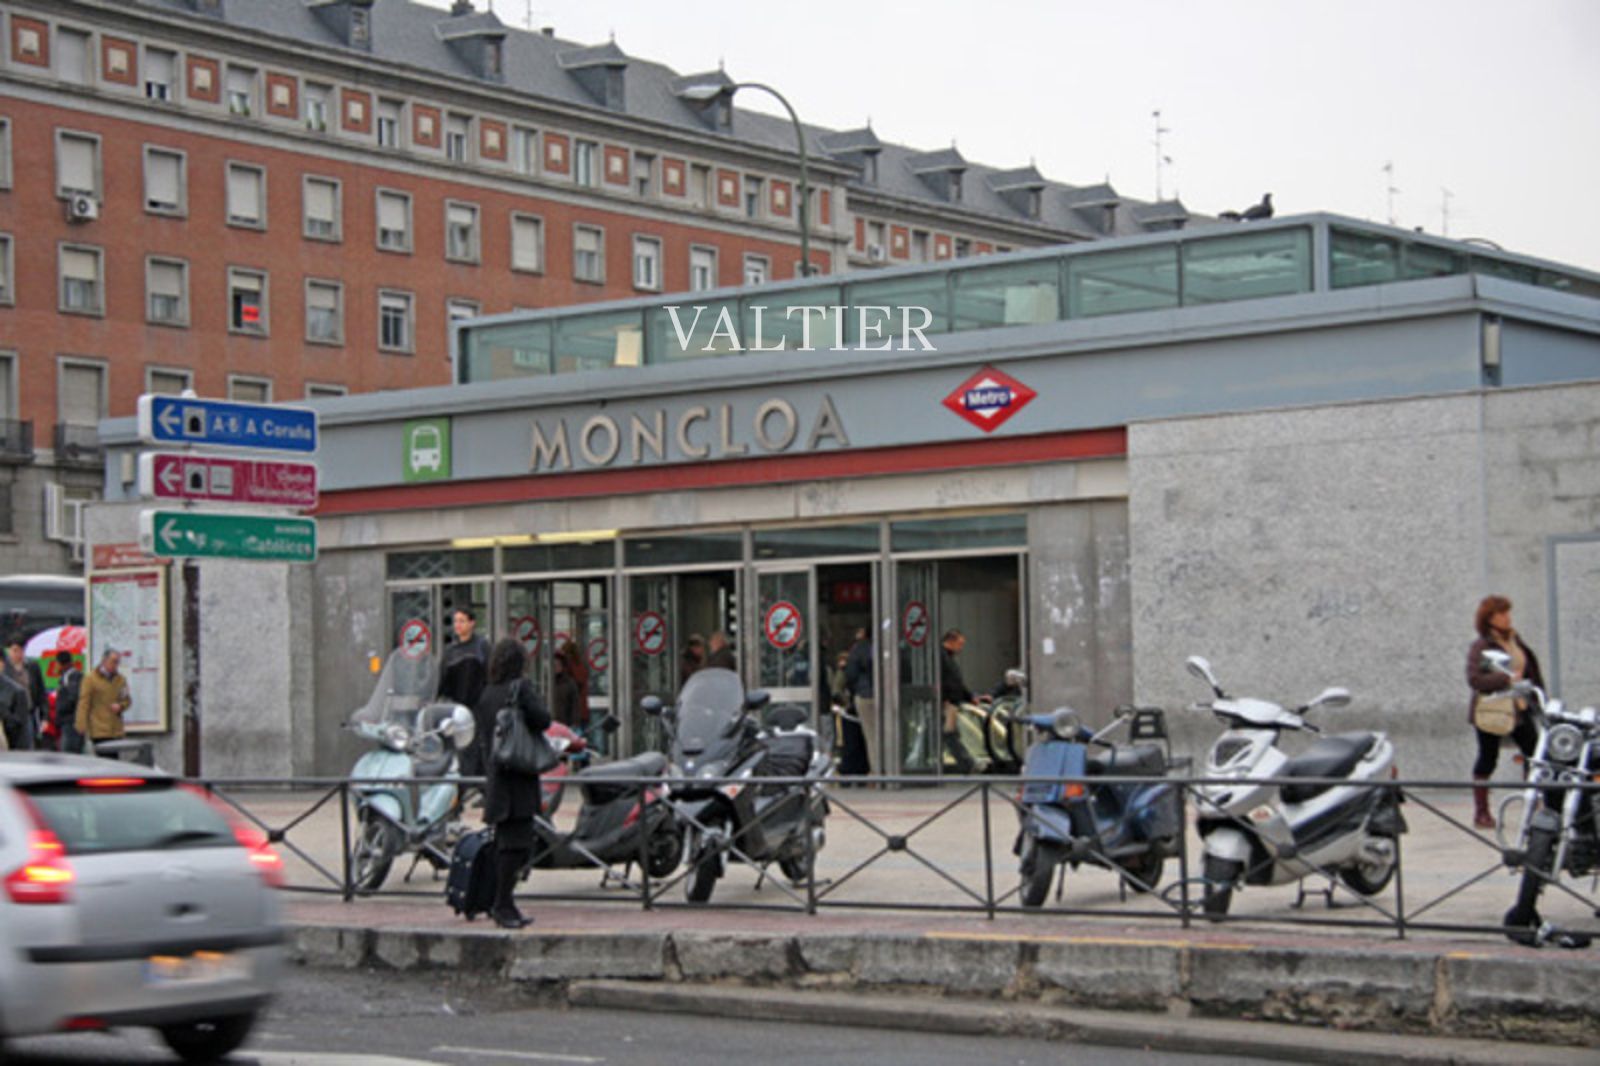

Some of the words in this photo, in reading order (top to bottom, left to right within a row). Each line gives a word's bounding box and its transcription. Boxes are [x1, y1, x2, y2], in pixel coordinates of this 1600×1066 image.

[967, 391, 1009, 406] Metro
[246, 418, 257, 436] A
[528, 395, 849, 472] MONCLOA
